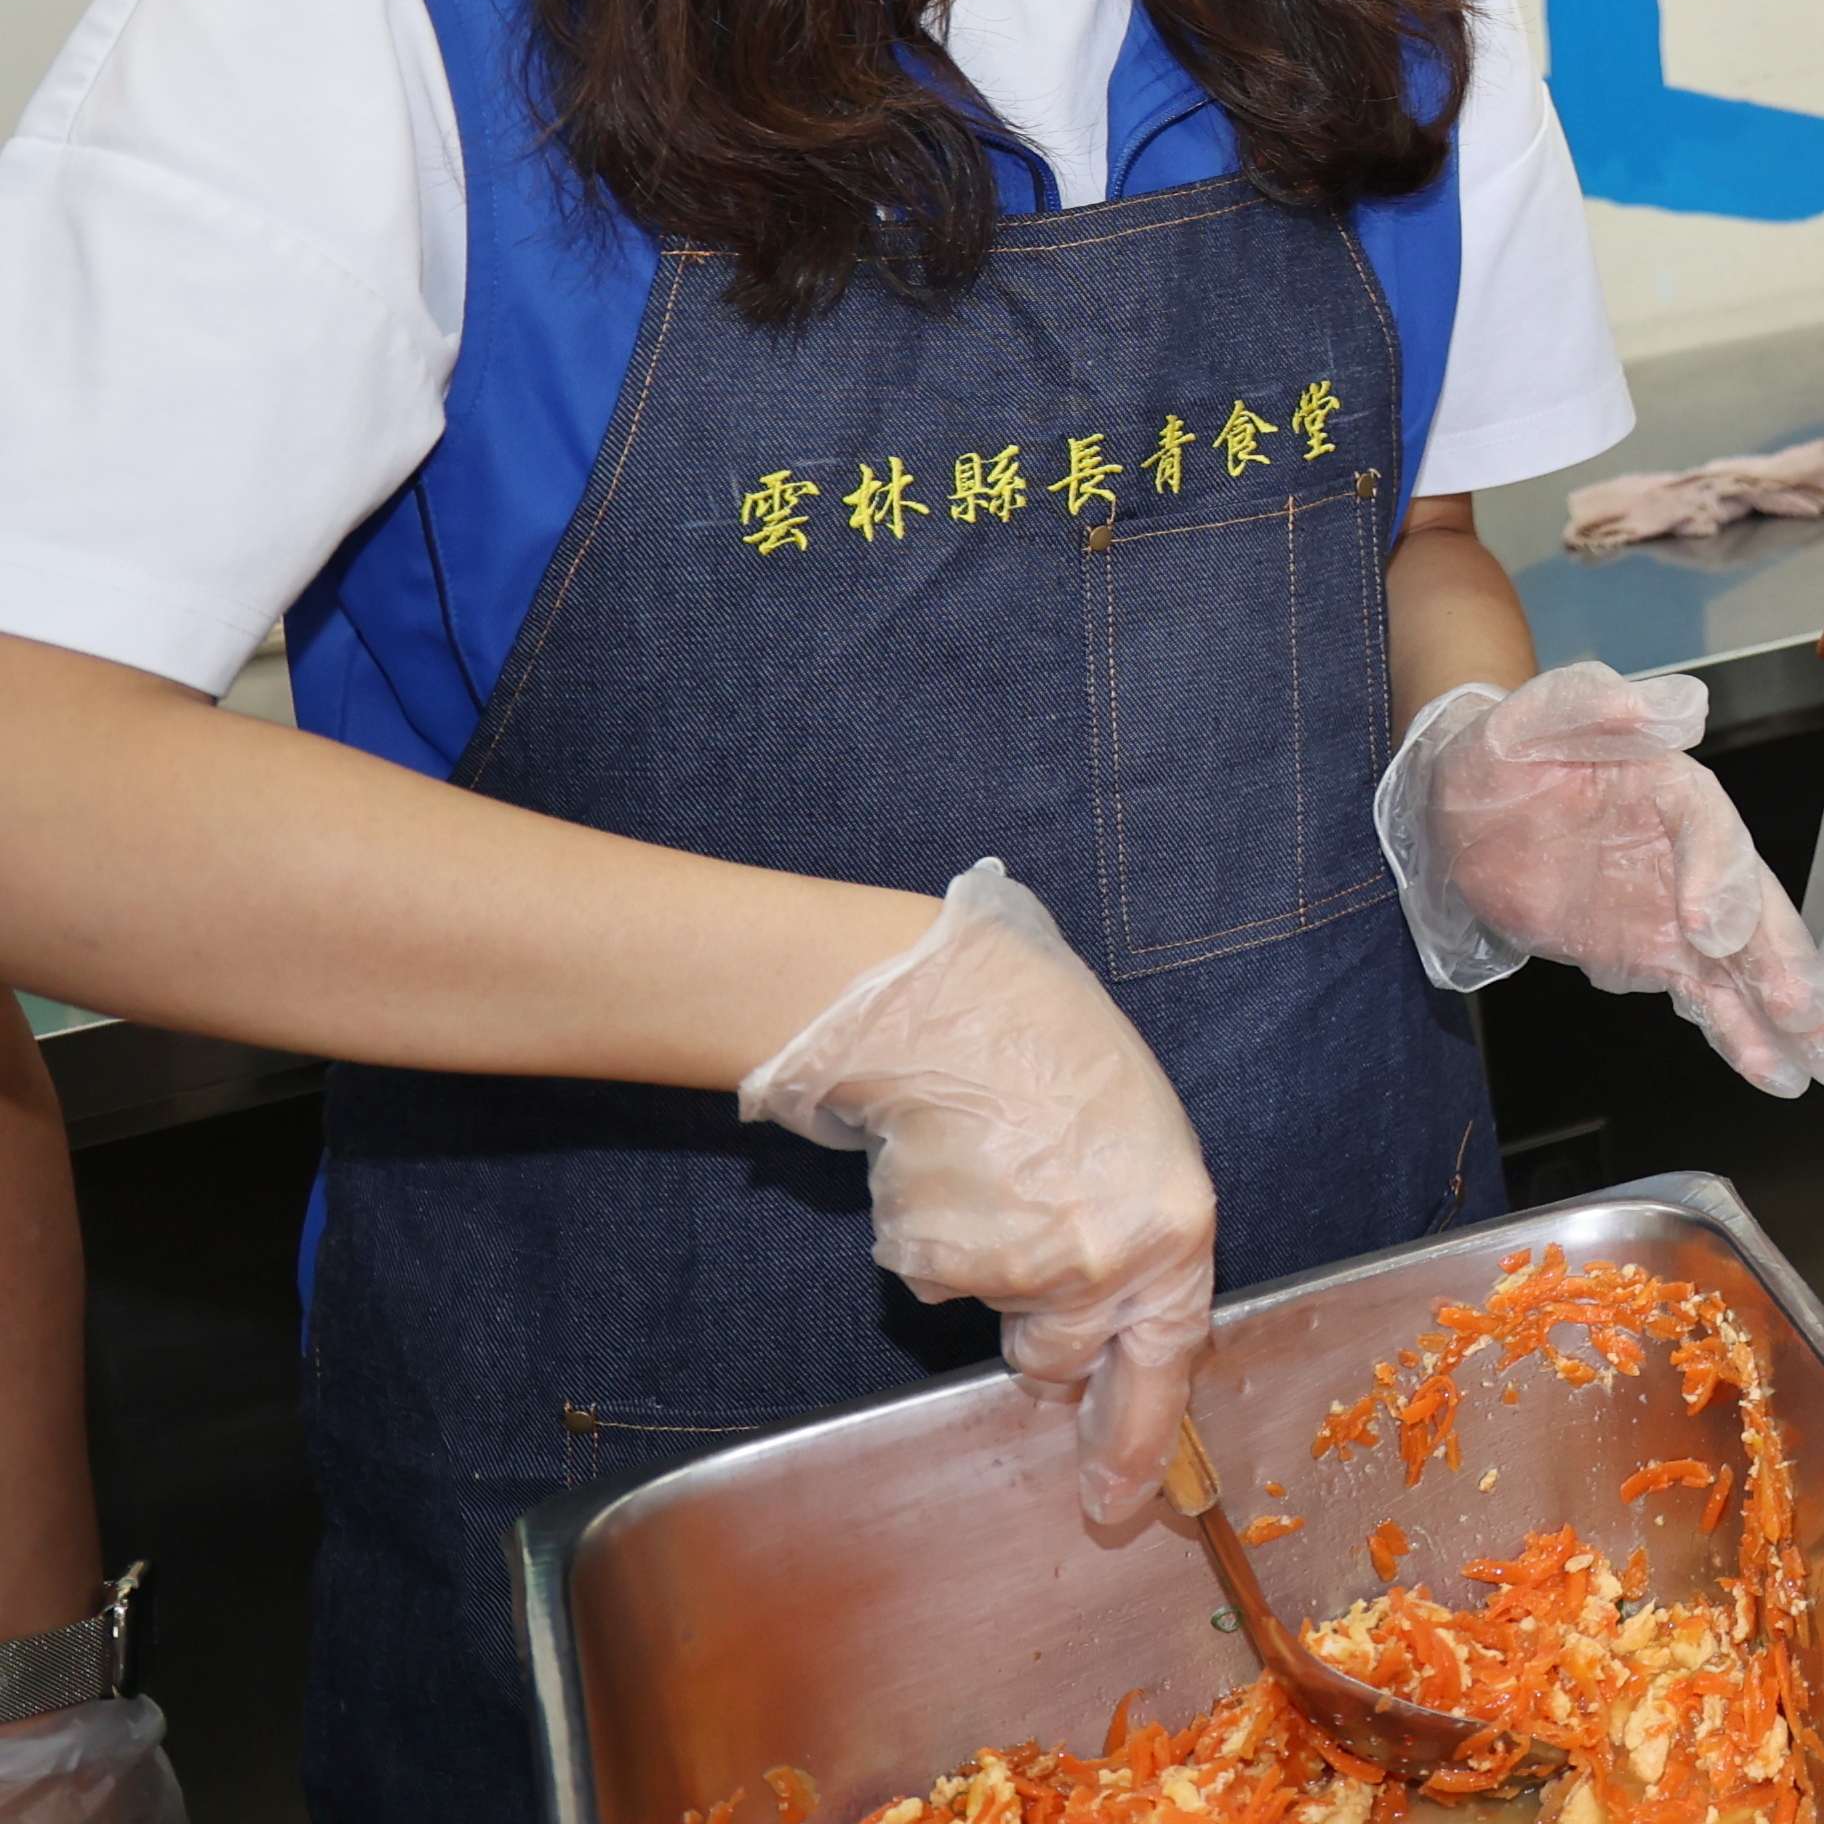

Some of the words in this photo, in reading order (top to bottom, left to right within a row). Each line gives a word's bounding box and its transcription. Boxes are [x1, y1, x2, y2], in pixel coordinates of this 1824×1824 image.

[738, 379, 1341, 556] 雲林縣長青食堂
